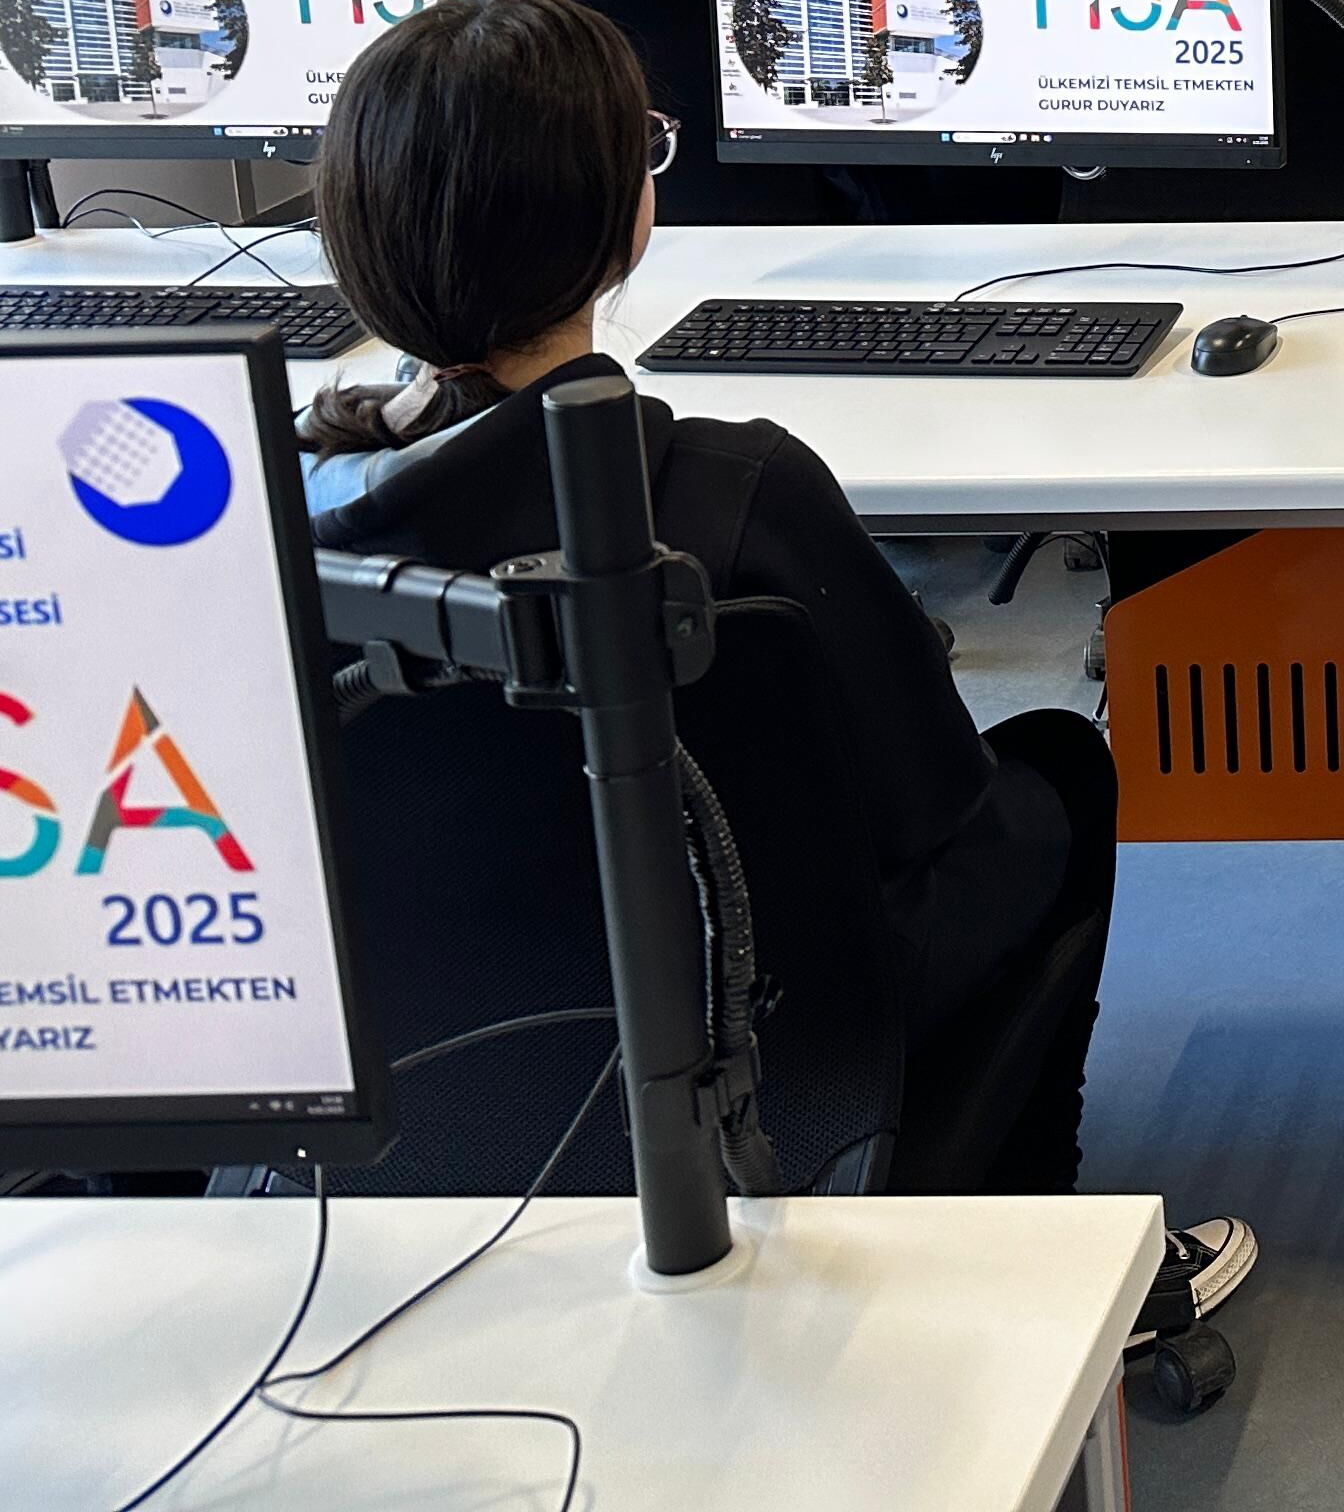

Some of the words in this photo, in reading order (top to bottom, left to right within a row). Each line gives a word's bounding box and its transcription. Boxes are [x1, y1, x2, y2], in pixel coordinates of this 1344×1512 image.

[1175, 39, 1244, 65] 2025
[306, 70, 346, 83] ÜLKE
[1038, 75, 1110, 90] ÜLKEMİZİ
[1114, 76, 1169, 90] TEMSİL
[1173, 79, 1254, 91] ETMEKTEN
[1038, 99, 1093, 111] GURUR
[1098, 99, 1165, 111] DUYARIZ
[0, 592, 62, 625] SESİ
[102, 892, 265, 946] 2025
[0, 974, 101, 1005] EMSİL
[109, 977, 297, 1004] ETMEKTEN
